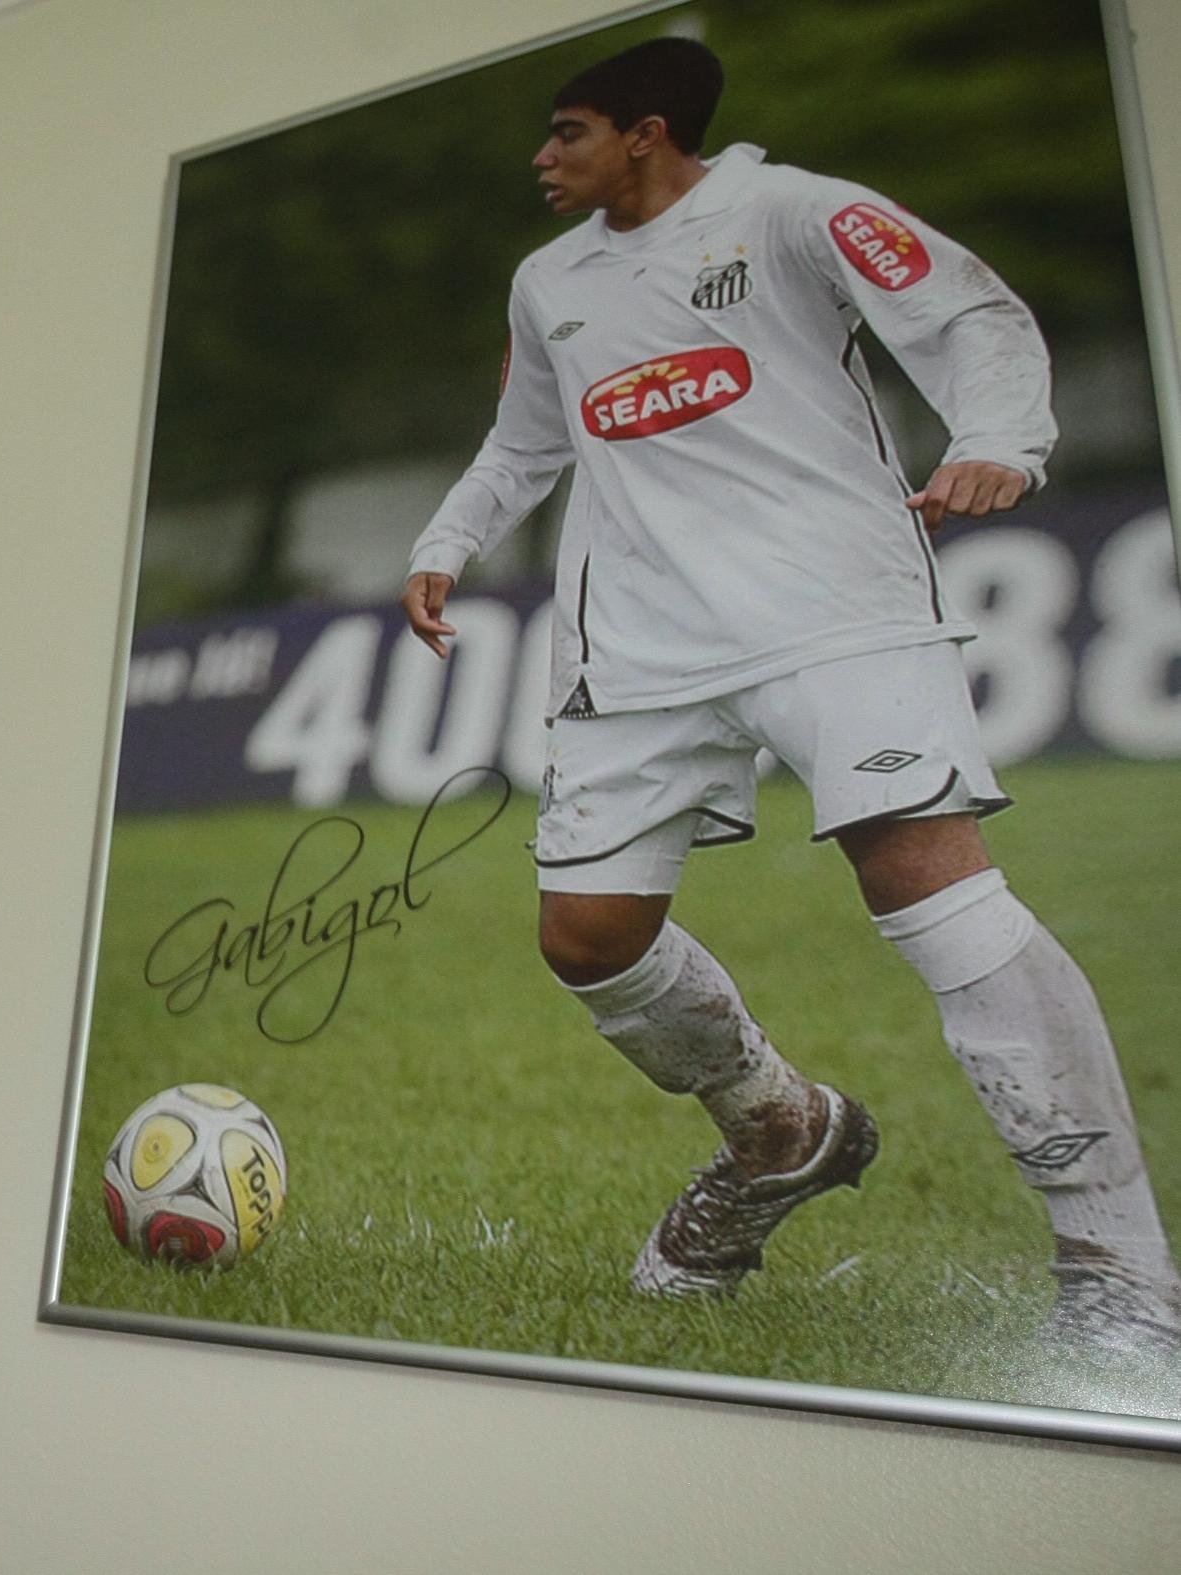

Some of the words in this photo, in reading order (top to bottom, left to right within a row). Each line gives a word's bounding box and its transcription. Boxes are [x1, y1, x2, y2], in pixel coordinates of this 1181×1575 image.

[834, 213, 911, 288] SEARA
[594, 369, 740, 432] SEARA
[144, 766, 512, 1044] Gabigol
[242, 1145, 274, 1240] TOPP
